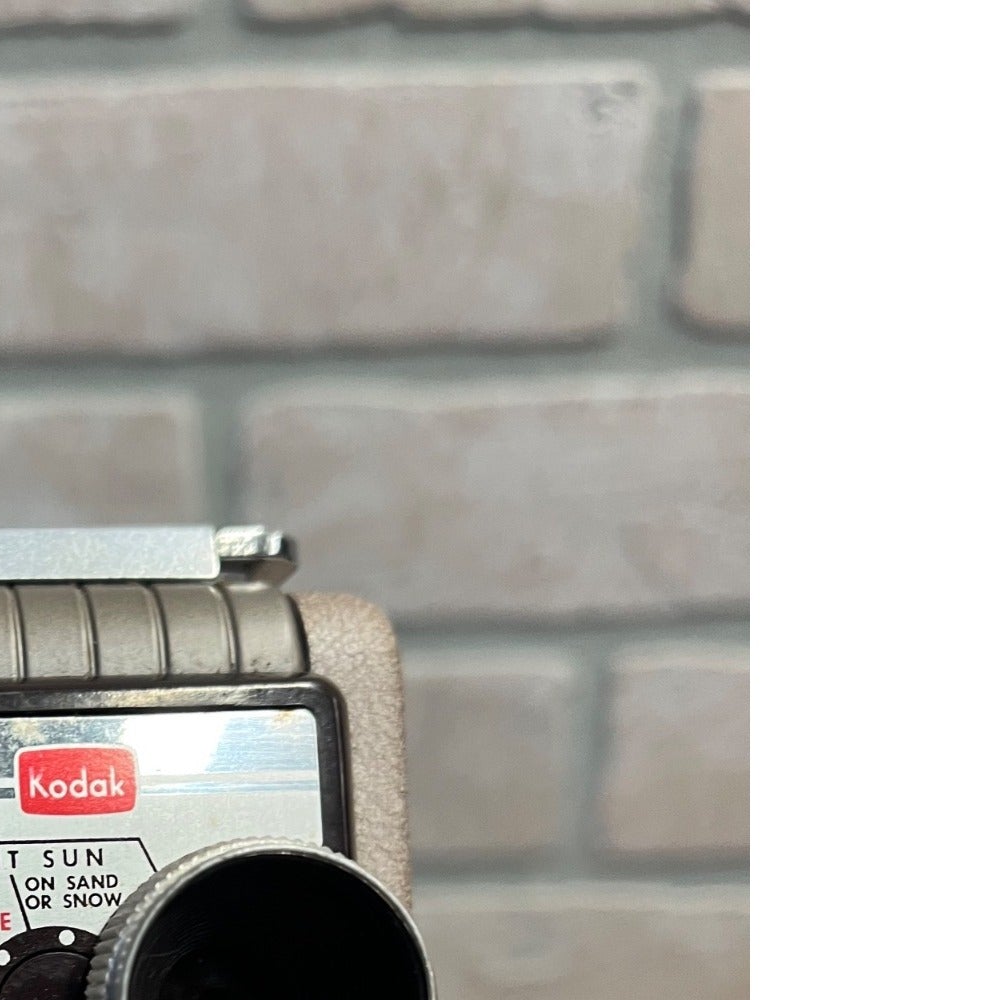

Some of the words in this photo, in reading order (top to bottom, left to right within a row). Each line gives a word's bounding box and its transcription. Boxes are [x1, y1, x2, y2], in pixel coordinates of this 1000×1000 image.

[29, 766, 126, 799] Kodak
[43, 849, 104, 868] SUN
[25, 876, 55, 892] ON
[67, 874, 119, 890] SAND
[25, 894, 52, 911] OR
[64, 892, 122, 909] SNOW
